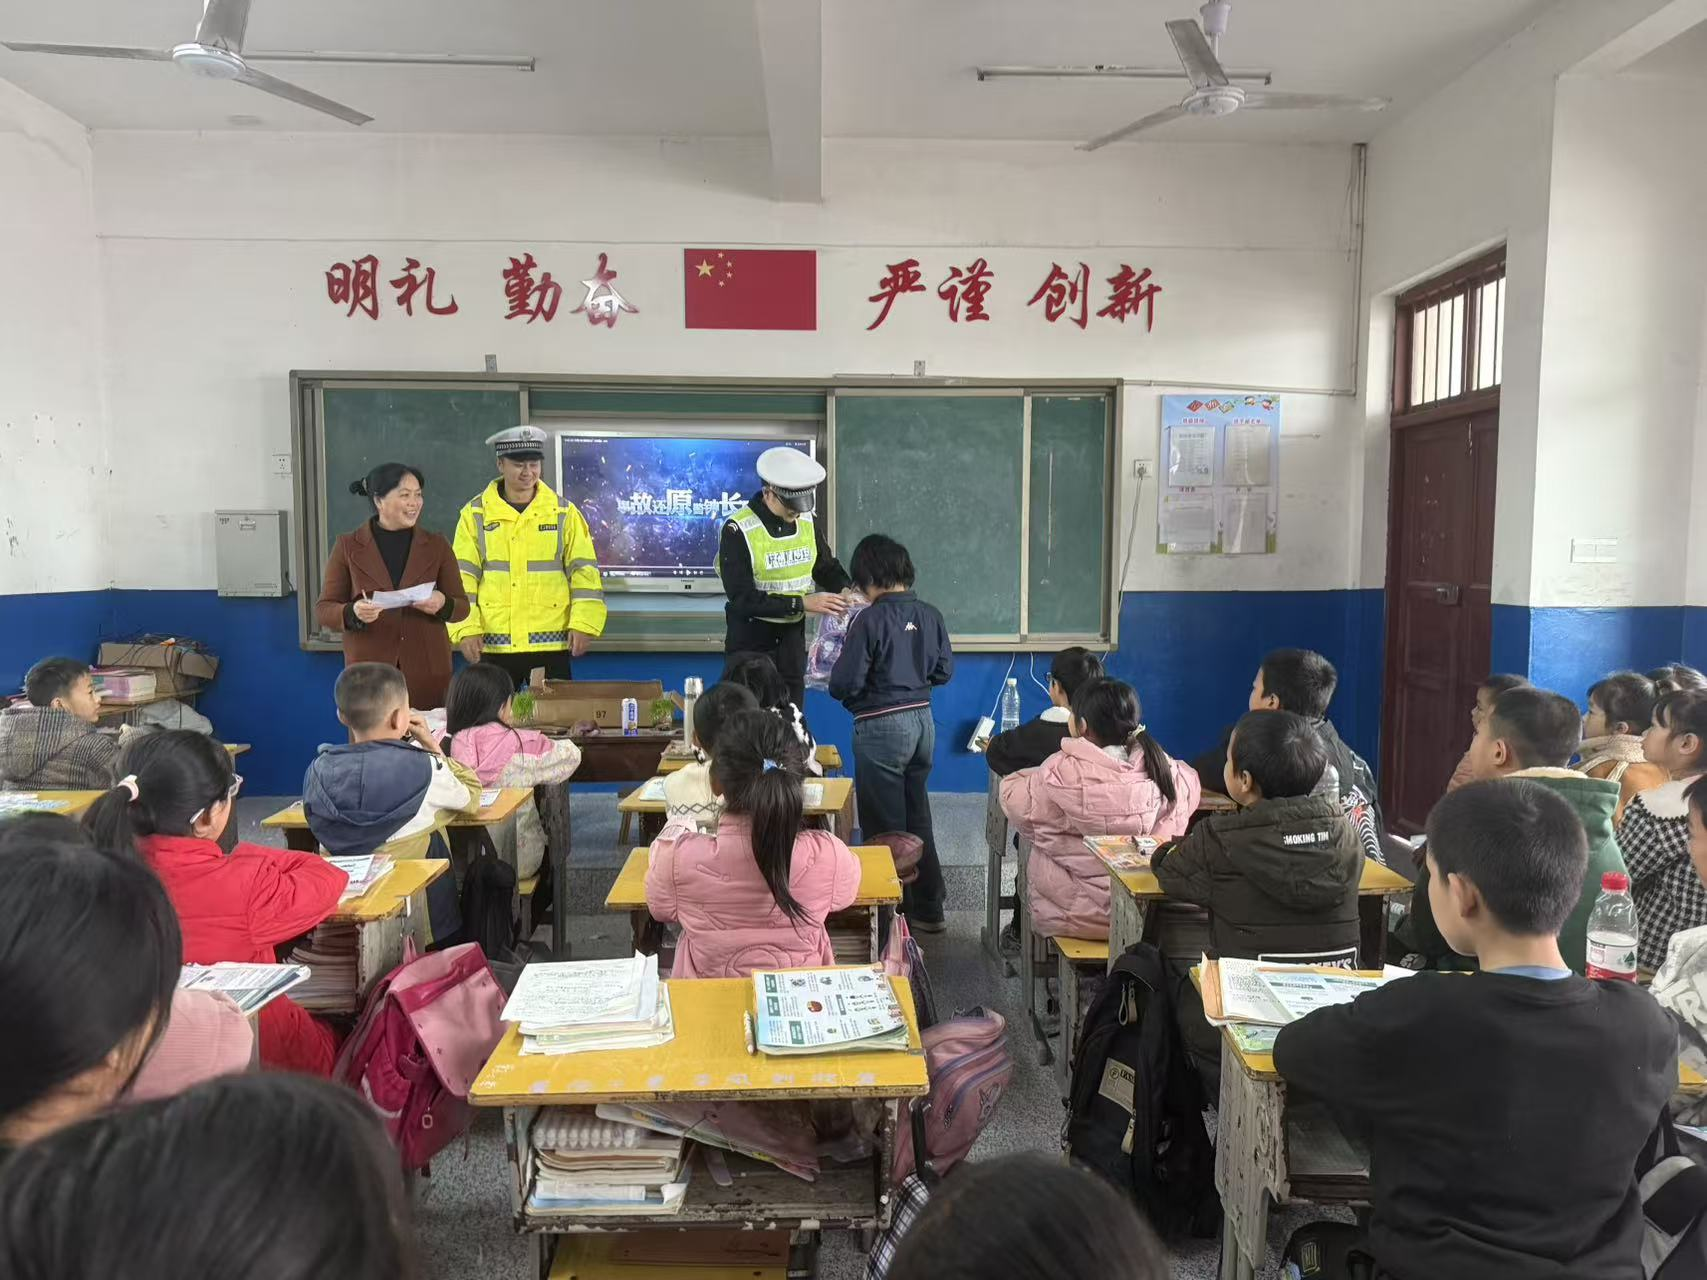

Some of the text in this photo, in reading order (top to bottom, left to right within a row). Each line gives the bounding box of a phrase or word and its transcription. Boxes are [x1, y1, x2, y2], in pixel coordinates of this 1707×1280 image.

[325, 251, 1163, 333] 明礼 勤奋 严谨 创新
[595, 710, 607, 719] 97
